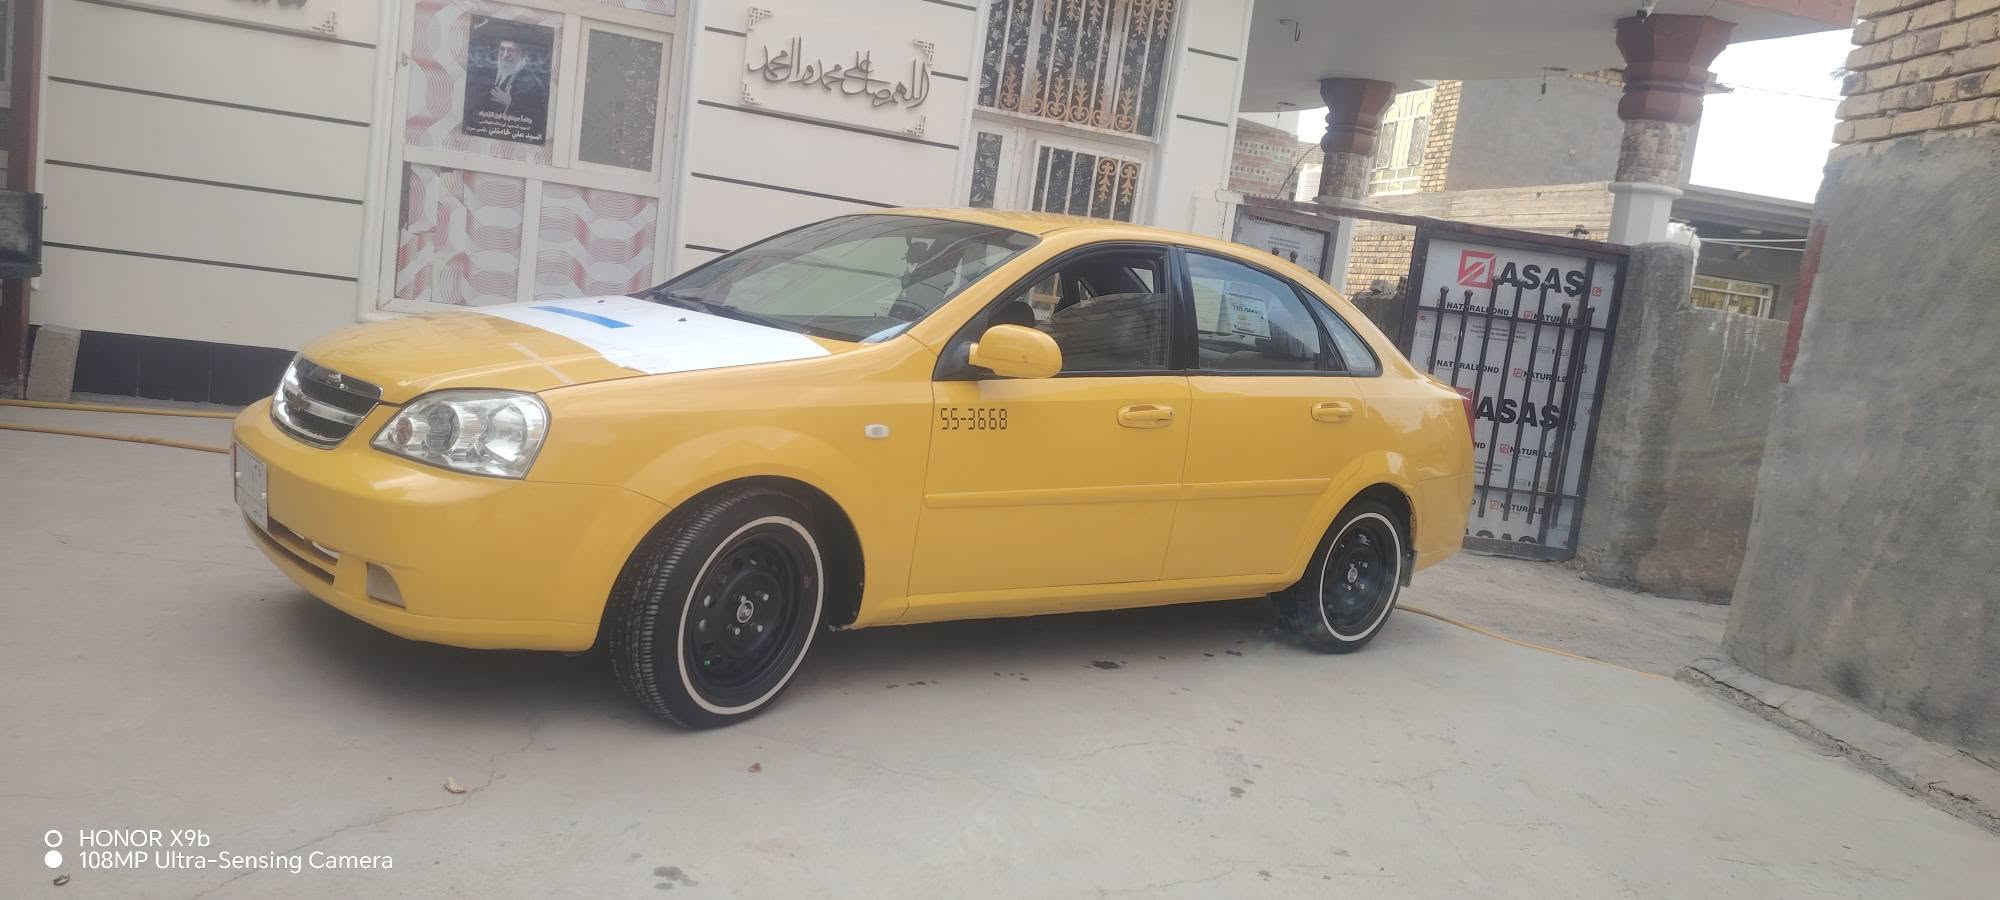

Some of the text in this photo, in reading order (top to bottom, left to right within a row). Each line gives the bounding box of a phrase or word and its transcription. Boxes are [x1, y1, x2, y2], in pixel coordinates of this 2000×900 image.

[1496, 261, 1585, 297] ASAS
[940, 407, 1008, 430] 55-3668
[1471, 396, 1561, 430] ASAS
